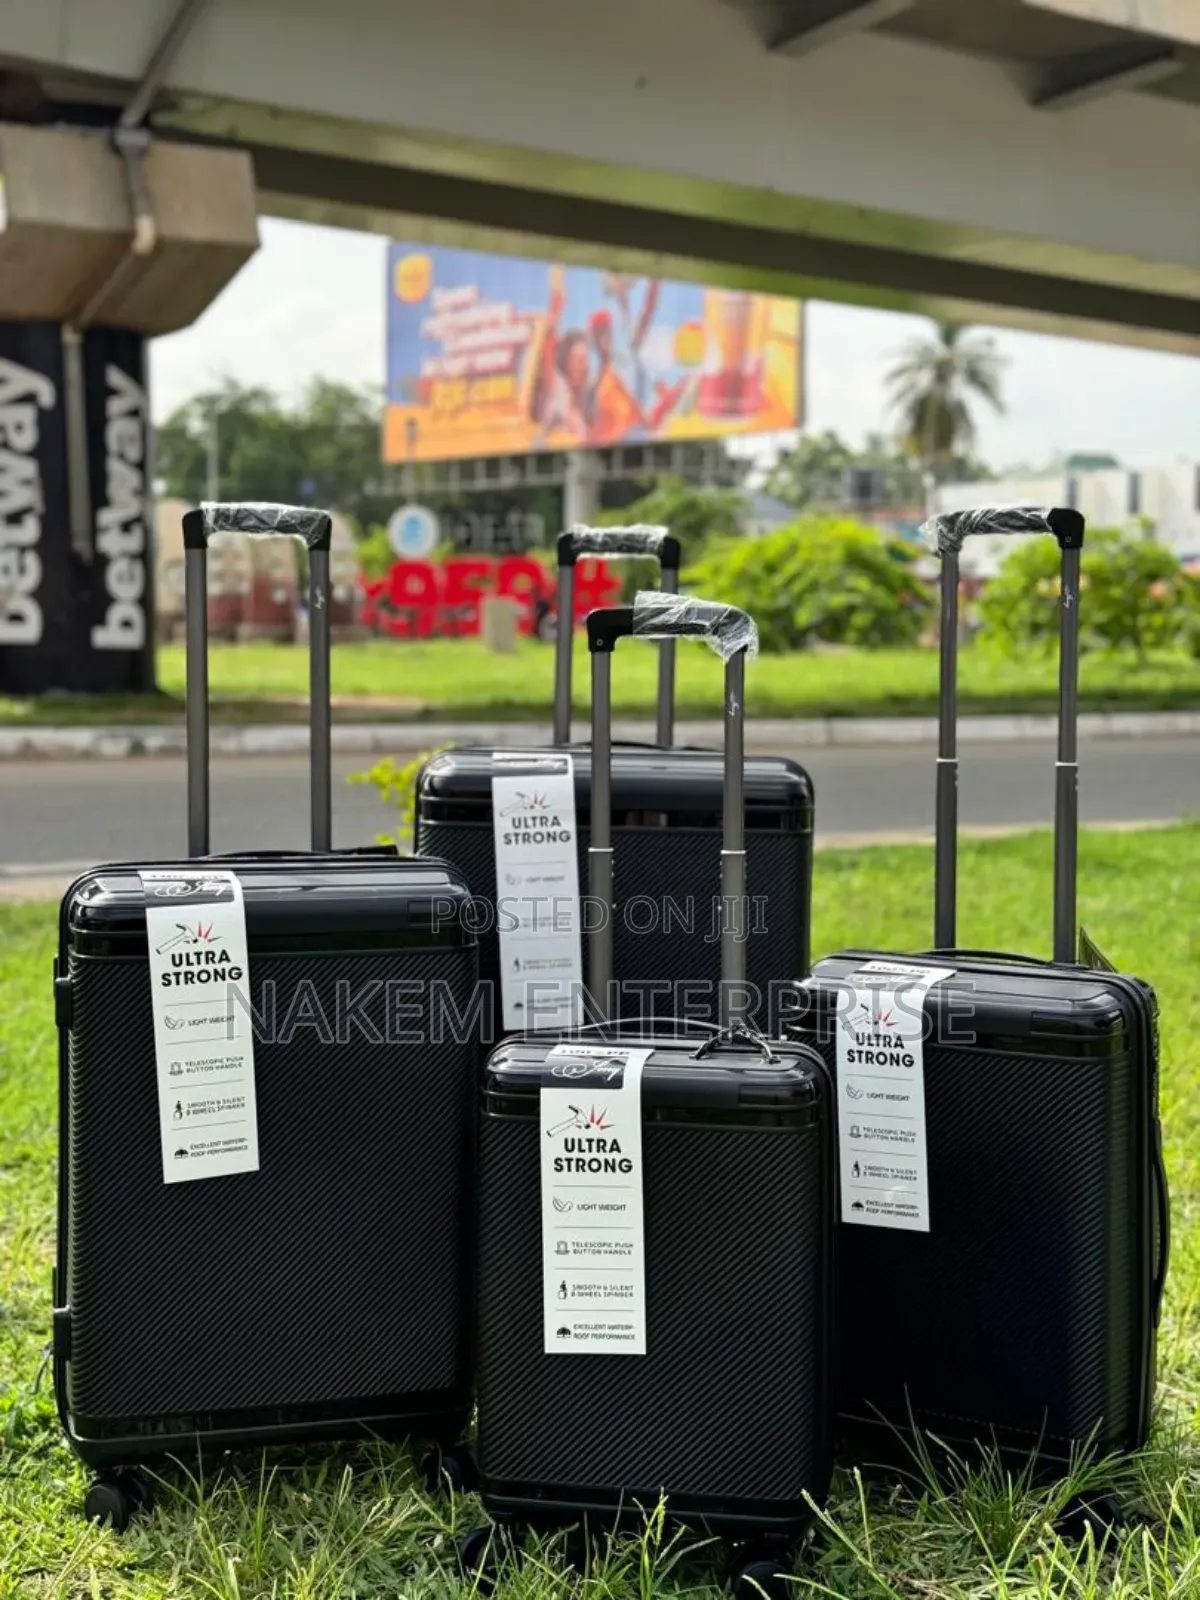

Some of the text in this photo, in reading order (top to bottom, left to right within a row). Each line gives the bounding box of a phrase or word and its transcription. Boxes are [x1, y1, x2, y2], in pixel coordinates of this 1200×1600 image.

[91, 363, 148, 649] betway
[512, 816, 561, 829] ULTRA
[503, 830, 571, 845] STRONG
[171, 949, 231, 967] ULTRA
[161, 966, 243, 987] STRONG
[855, 1032, 905, 1049] ULTRA
[847, 1049, 915, 1067] STRONG
[564, 1138, 621, 1153] ULTRA
[554, 1157, 633, 1173] STRONG
